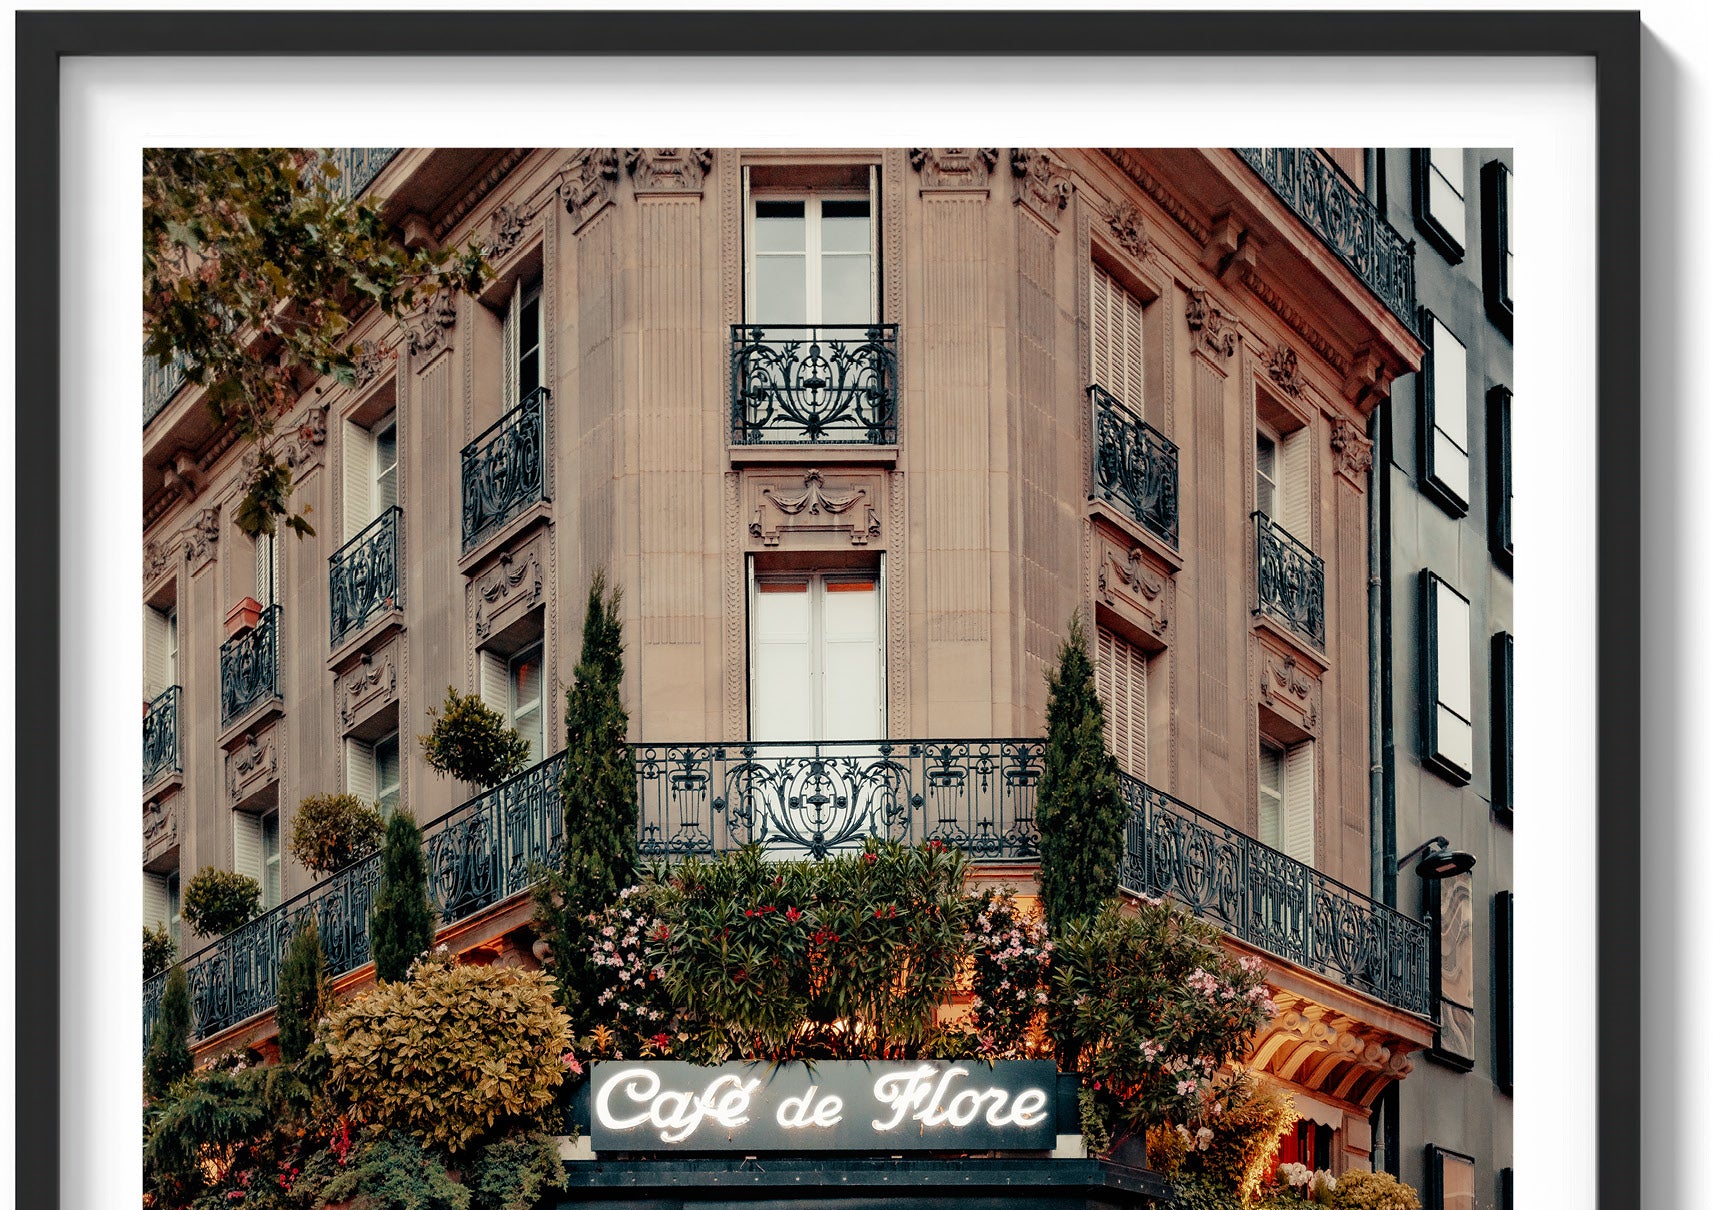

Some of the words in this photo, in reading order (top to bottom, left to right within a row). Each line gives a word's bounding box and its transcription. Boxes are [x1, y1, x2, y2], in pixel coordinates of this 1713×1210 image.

[595, 1067, 761, 1144] Café
[775, 1085, 844, 1129] de
[872, 1065, 1049, 1132] Flore
